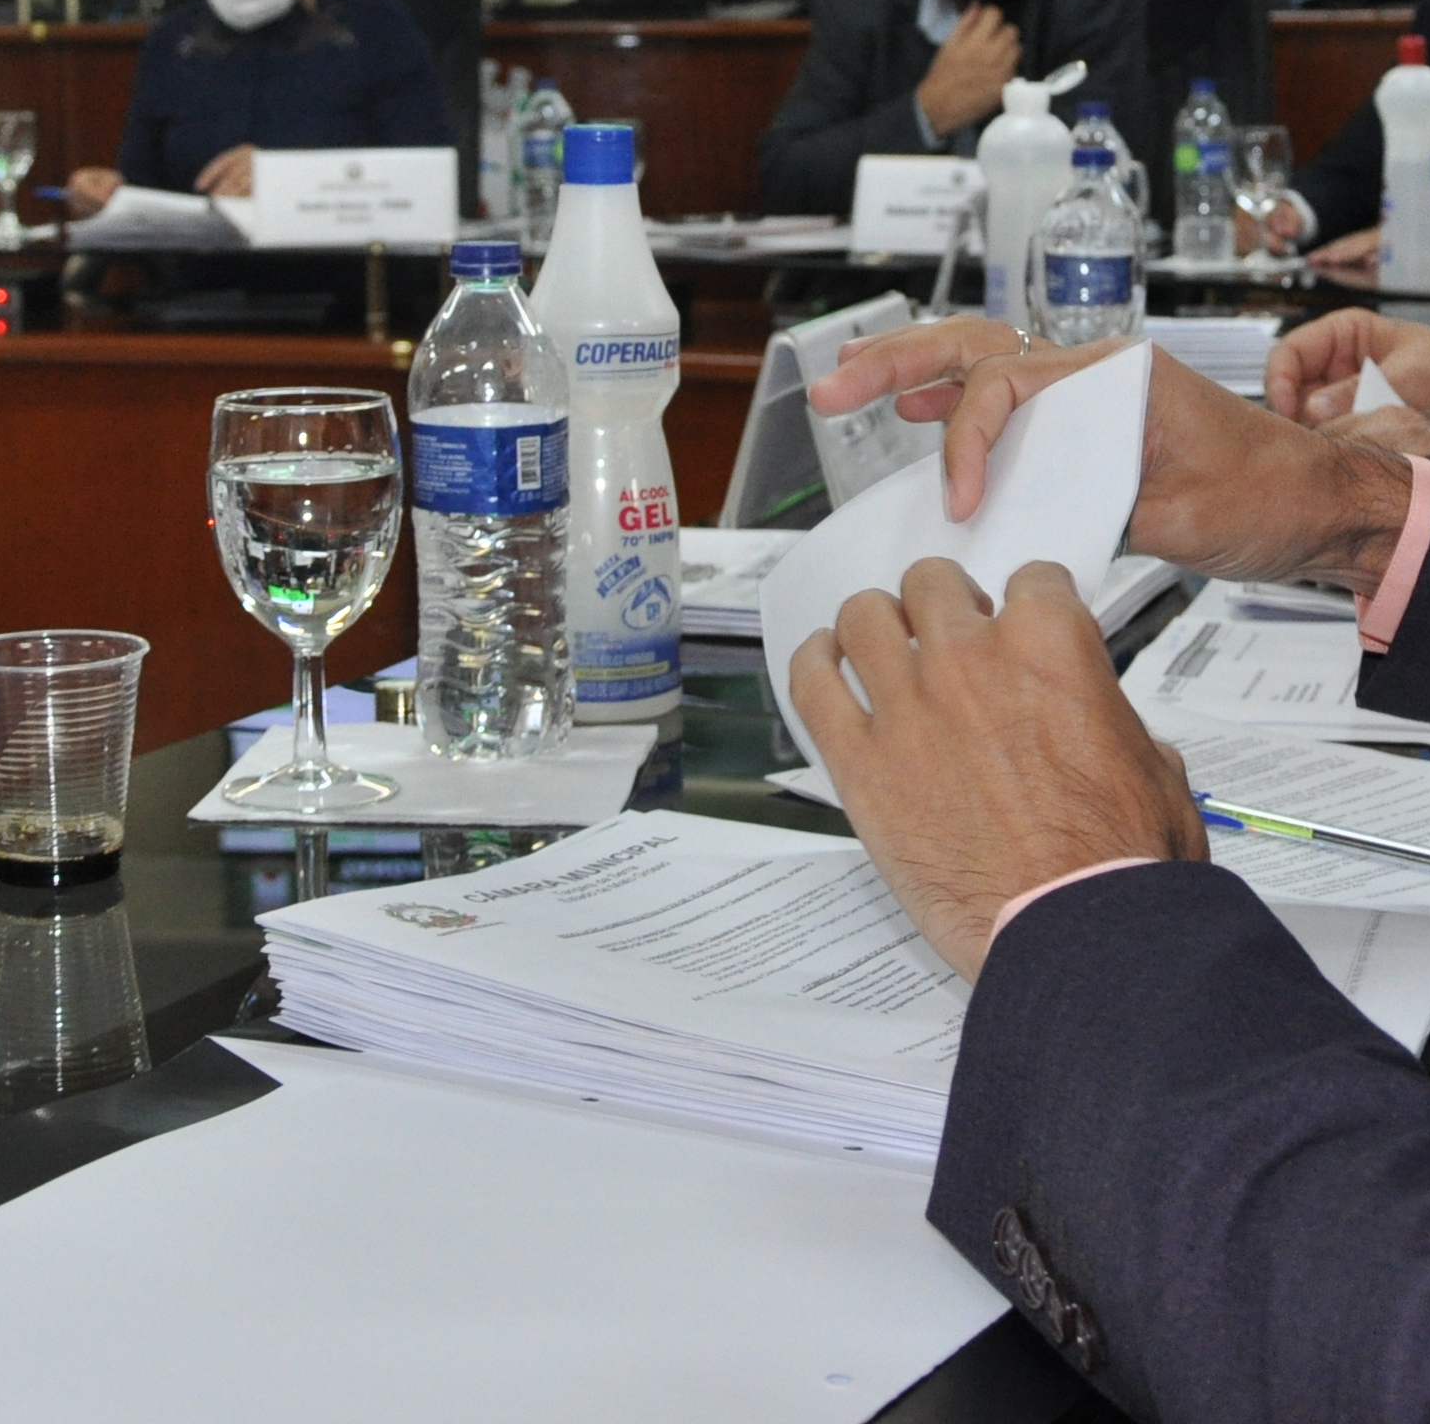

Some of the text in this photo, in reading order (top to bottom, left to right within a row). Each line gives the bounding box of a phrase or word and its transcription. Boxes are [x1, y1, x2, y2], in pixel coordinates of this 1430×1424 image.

[618, 501, 673, 532] GEL
[463, 836, 679, 904] CÂMARA MUNICIPAL
